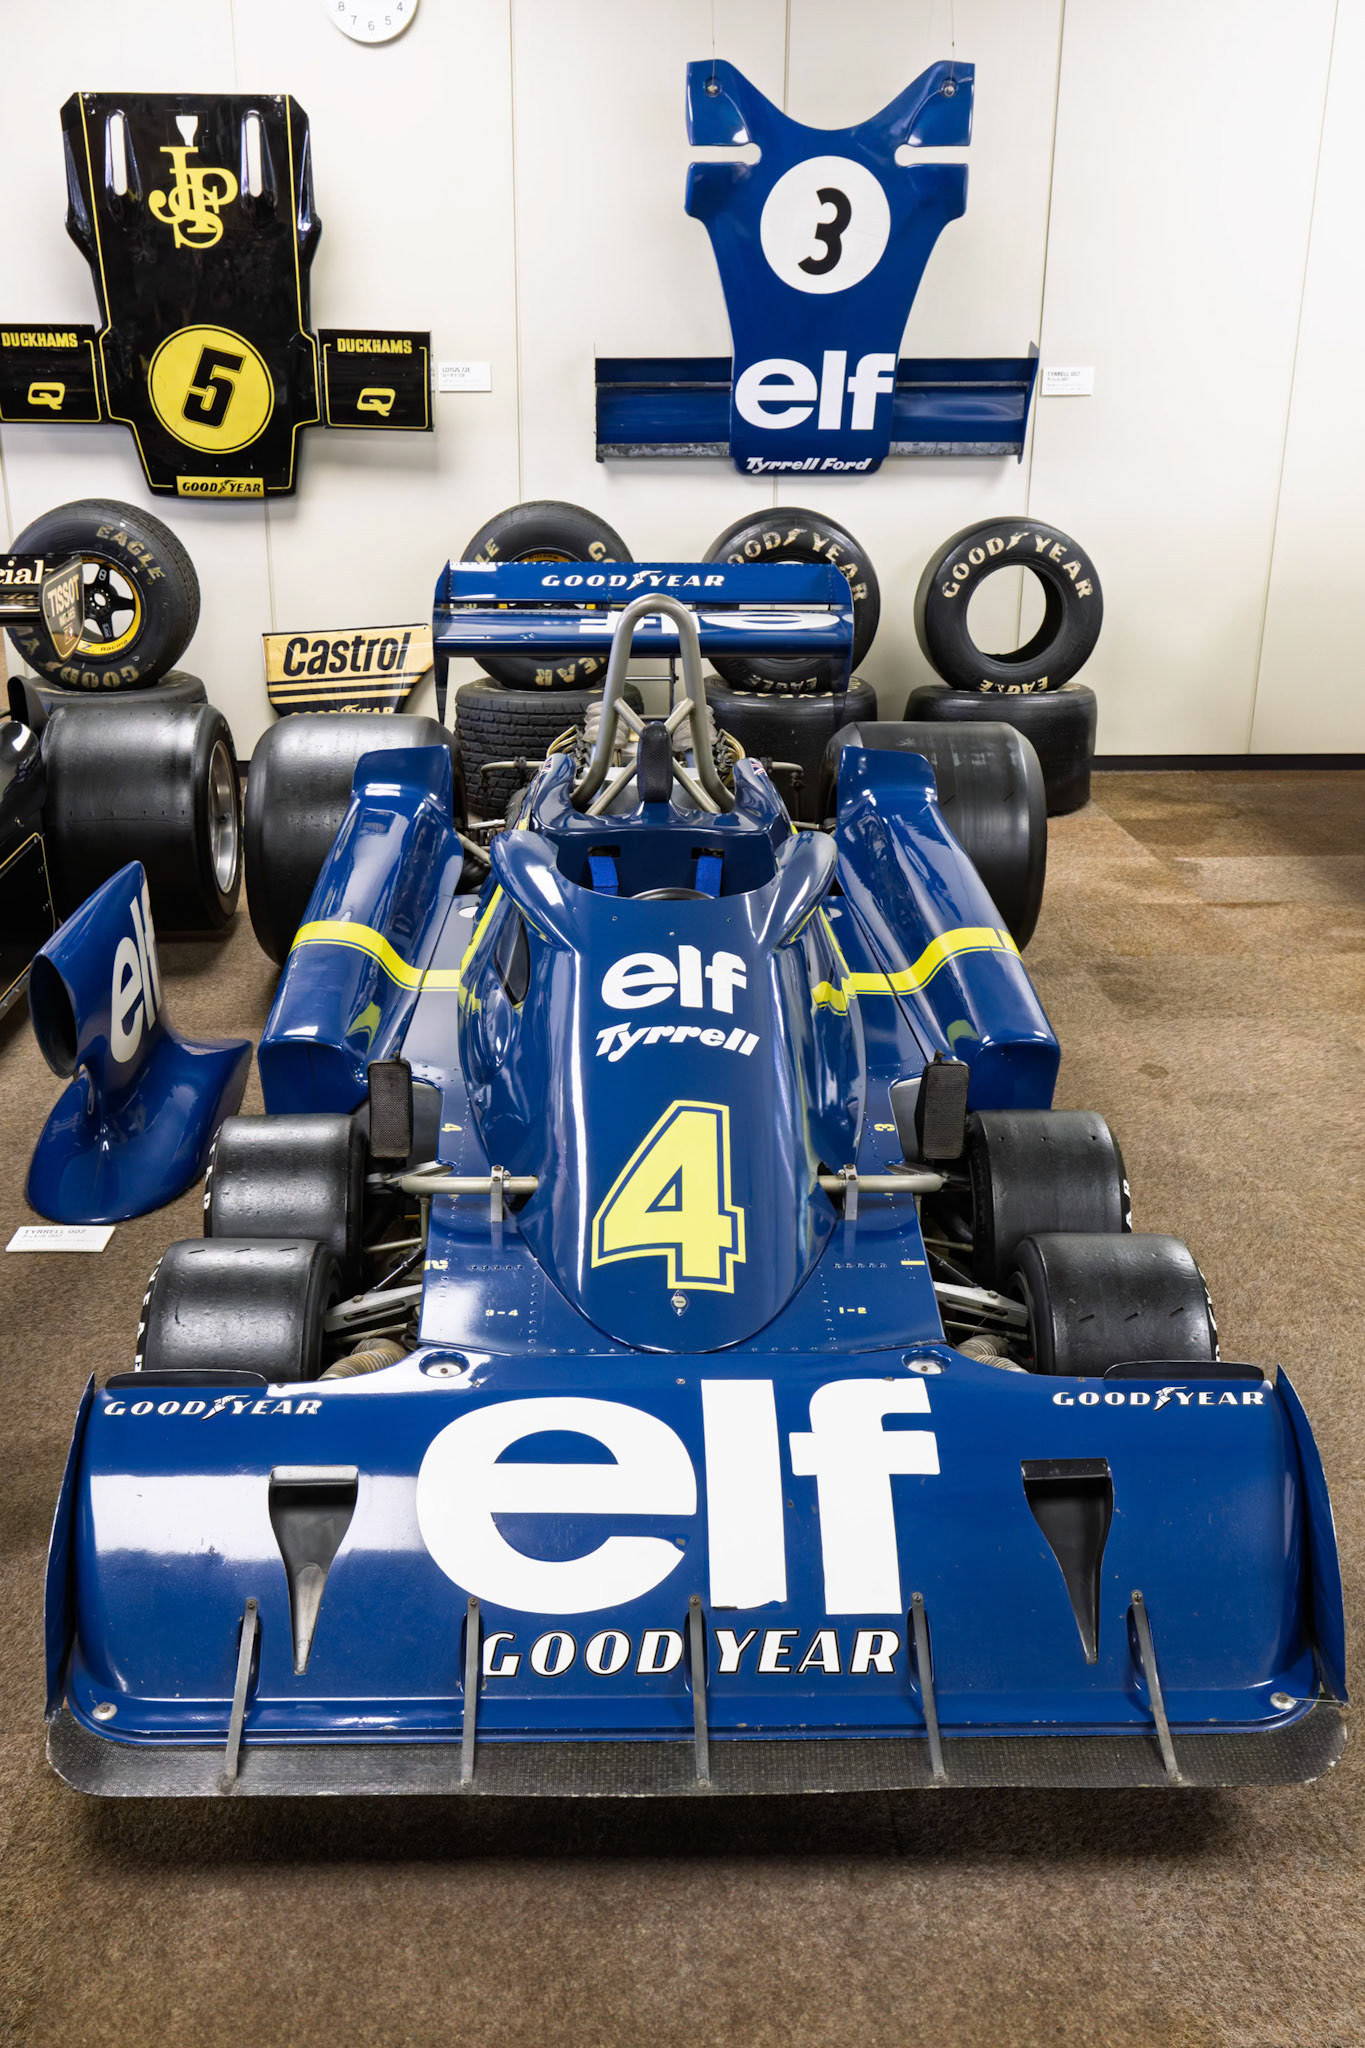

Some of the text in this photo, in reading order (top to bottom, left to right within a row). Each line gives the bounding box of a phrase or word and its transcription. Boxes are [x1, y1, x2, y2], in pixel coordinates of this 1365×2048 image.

[337, 1, 345, 12] 8
[351, 15, 357, 26] 7
[384, 15, 392, 26] 5
[396, 1, 403, 12] 4
[368, 20, 375, 31] 6
[797, 187, 852, 276] 3
[0, 332, 79, 348] DUCKHAMS
[336, 337, 413, 354] DUCKHAMS
[27, 382, 66, 411] Q
[181, 344, 247, 429] 5
[356, 387, 396, 417] Q
[735, 350, 896, 430] elf
[746, 457, 872, 474] Tyrrell Ford
[97, 526, 166, 580] EAGLE
[47, 573, 80, 617] TISSOT
[283, 632, 411, 677] Castrol
[601, 944, 747, 1015] elf
[595, 1021, 760, 1063] Tyrrell
[591, 1100, 747, 1294] 4
[416, 1377, 941, 1616] elf
